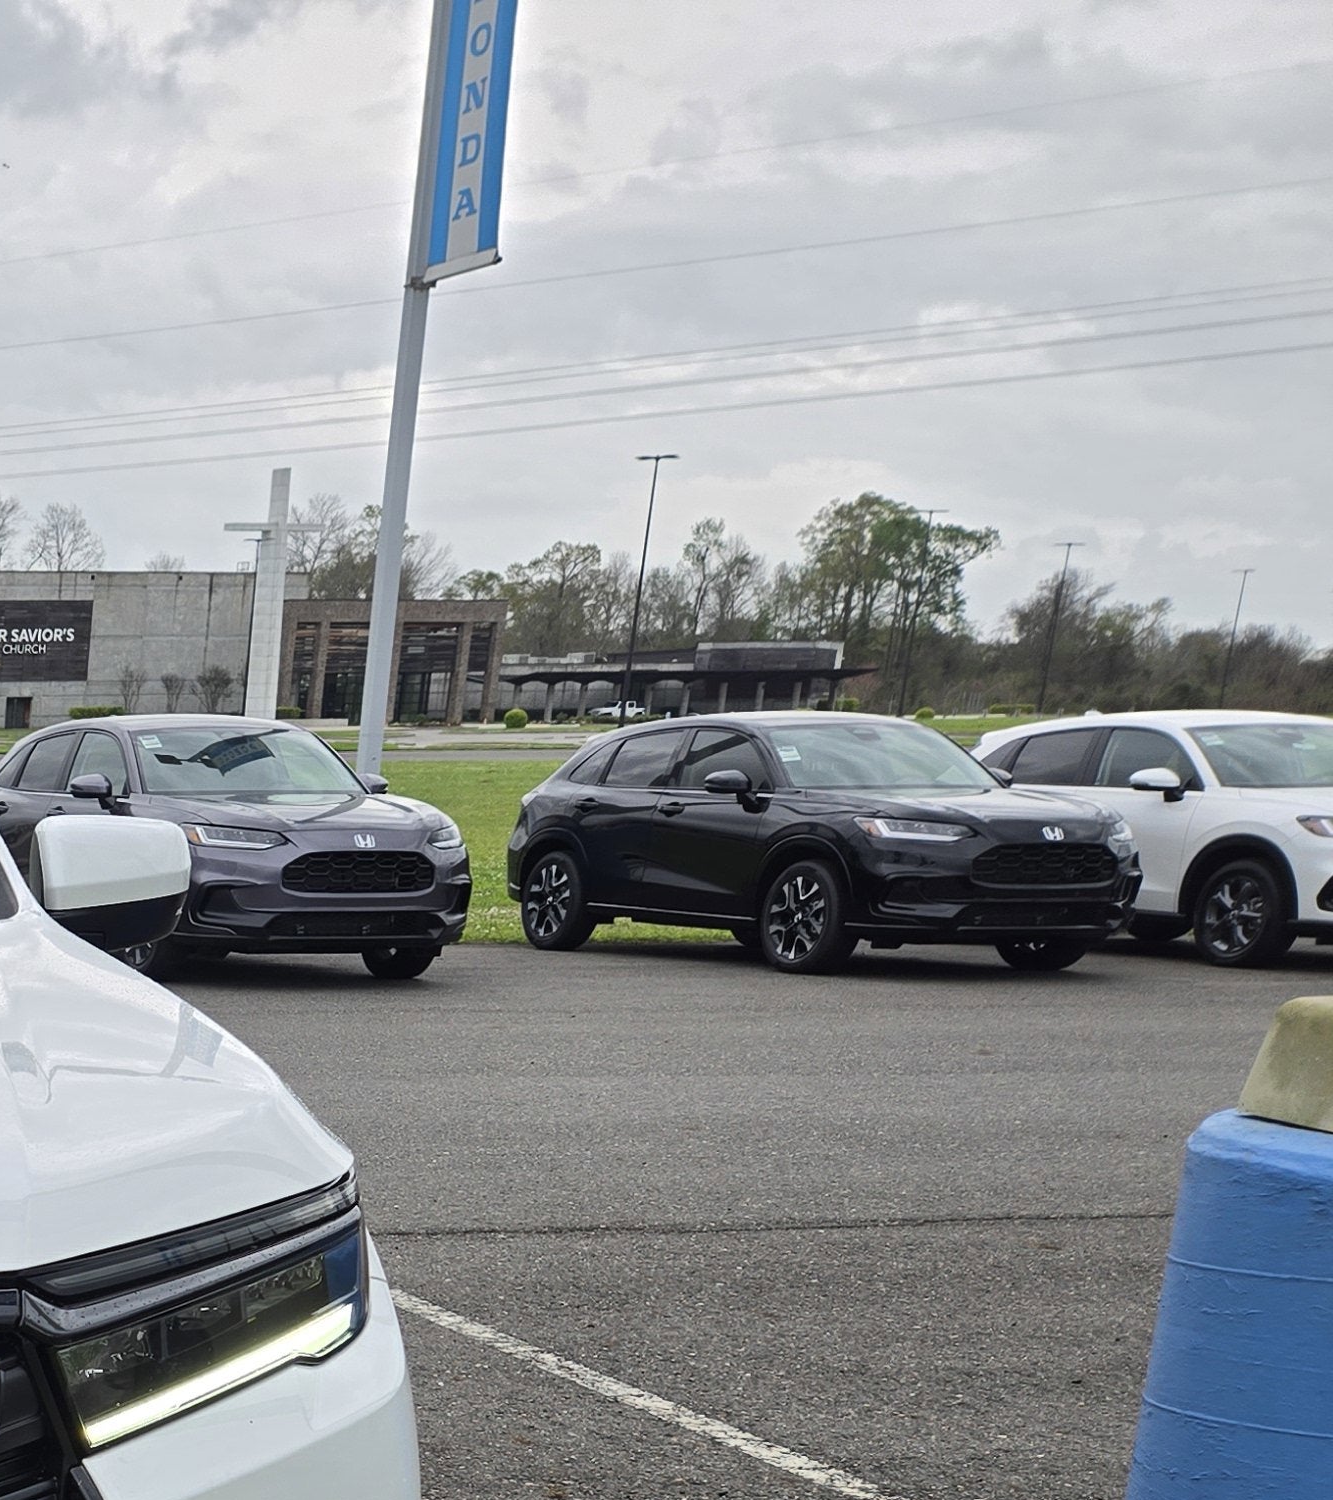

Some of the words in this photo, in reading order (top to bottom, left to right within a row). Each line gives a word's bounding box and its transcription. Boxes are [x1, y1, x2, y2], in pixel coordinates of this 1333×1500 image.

[452, 0, 492, 222] ONDA
[11, 627, 75, 643] SAVIOR'S
[2, 644, 47, 655] CHURCH
